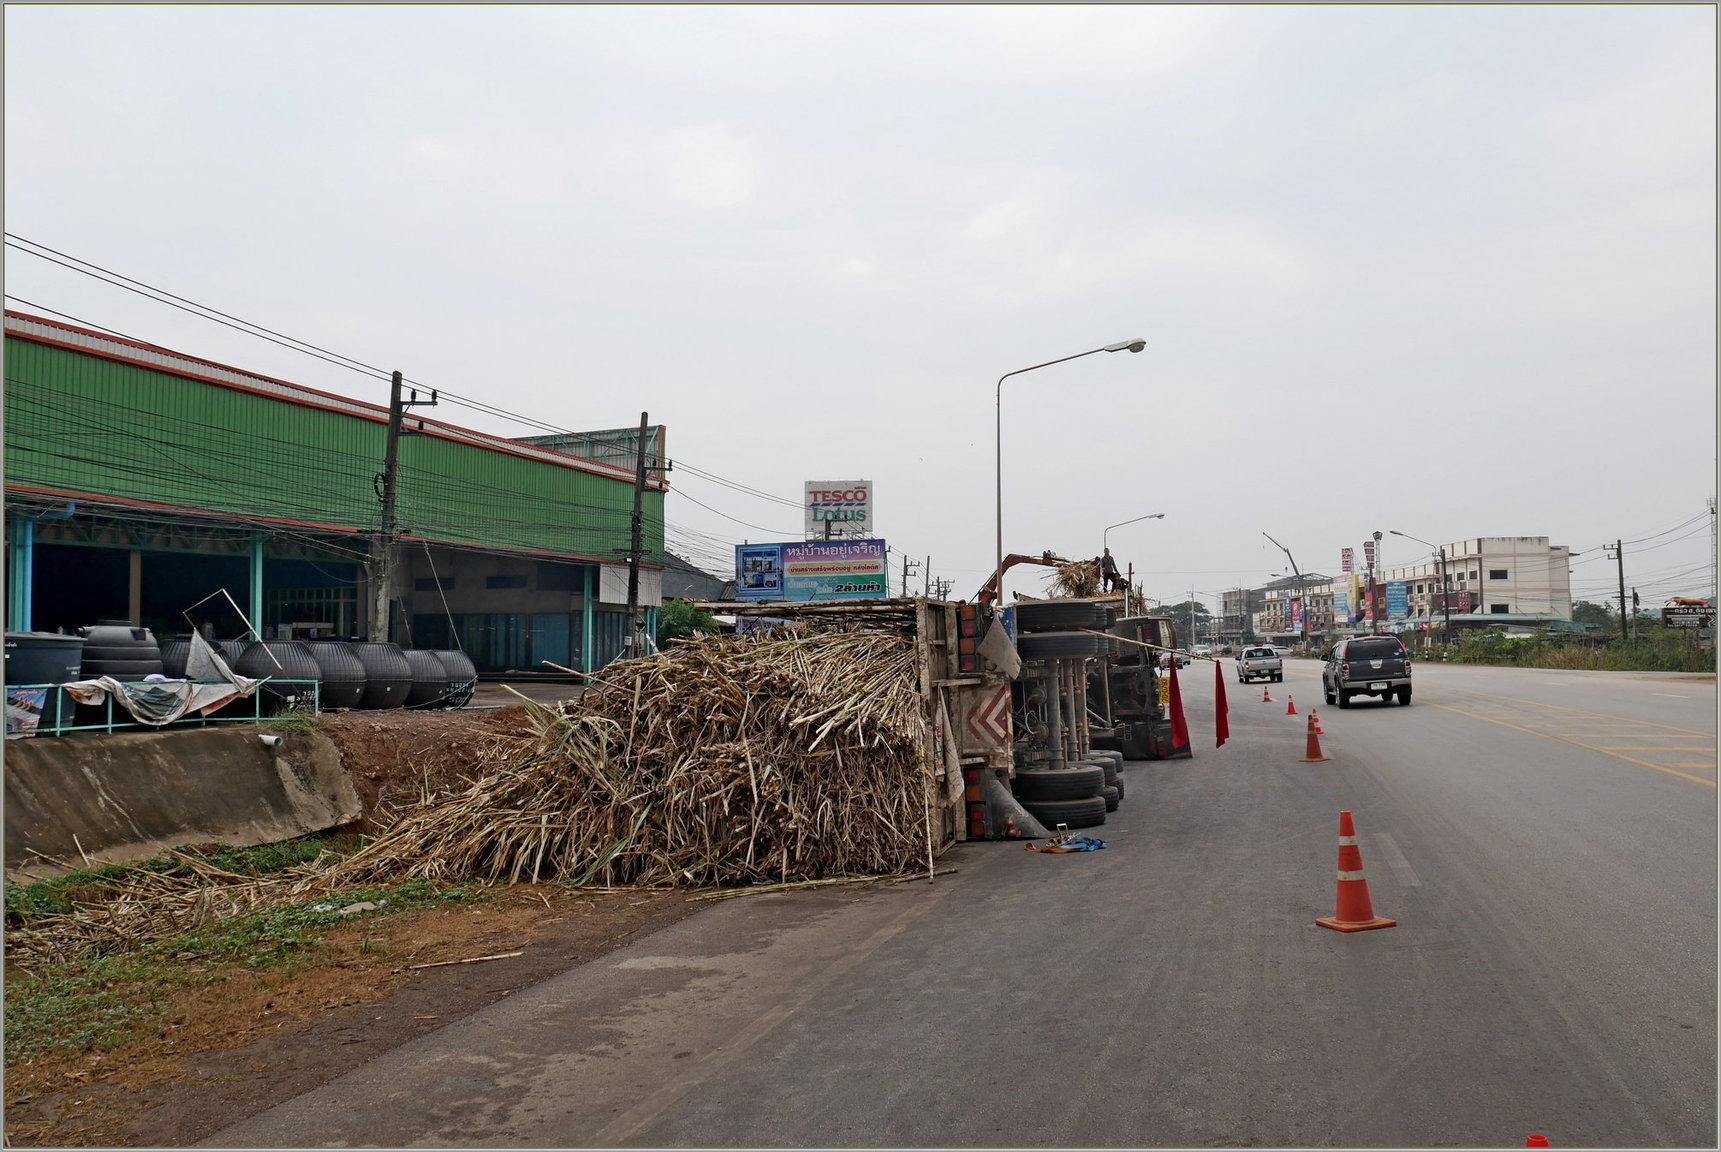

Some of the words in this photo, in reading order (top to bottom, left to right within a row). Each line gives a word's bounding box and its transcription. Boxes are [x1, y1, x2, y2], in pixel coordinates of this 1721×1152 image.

[809, 490, 867, 502] TESCO
[812, 507, 867, 522] Lotus
[786, 542, 881, 560] หมู่บ้านอยู่เจริญ
[834, 581, 881, 593] 2ล้านห้า
